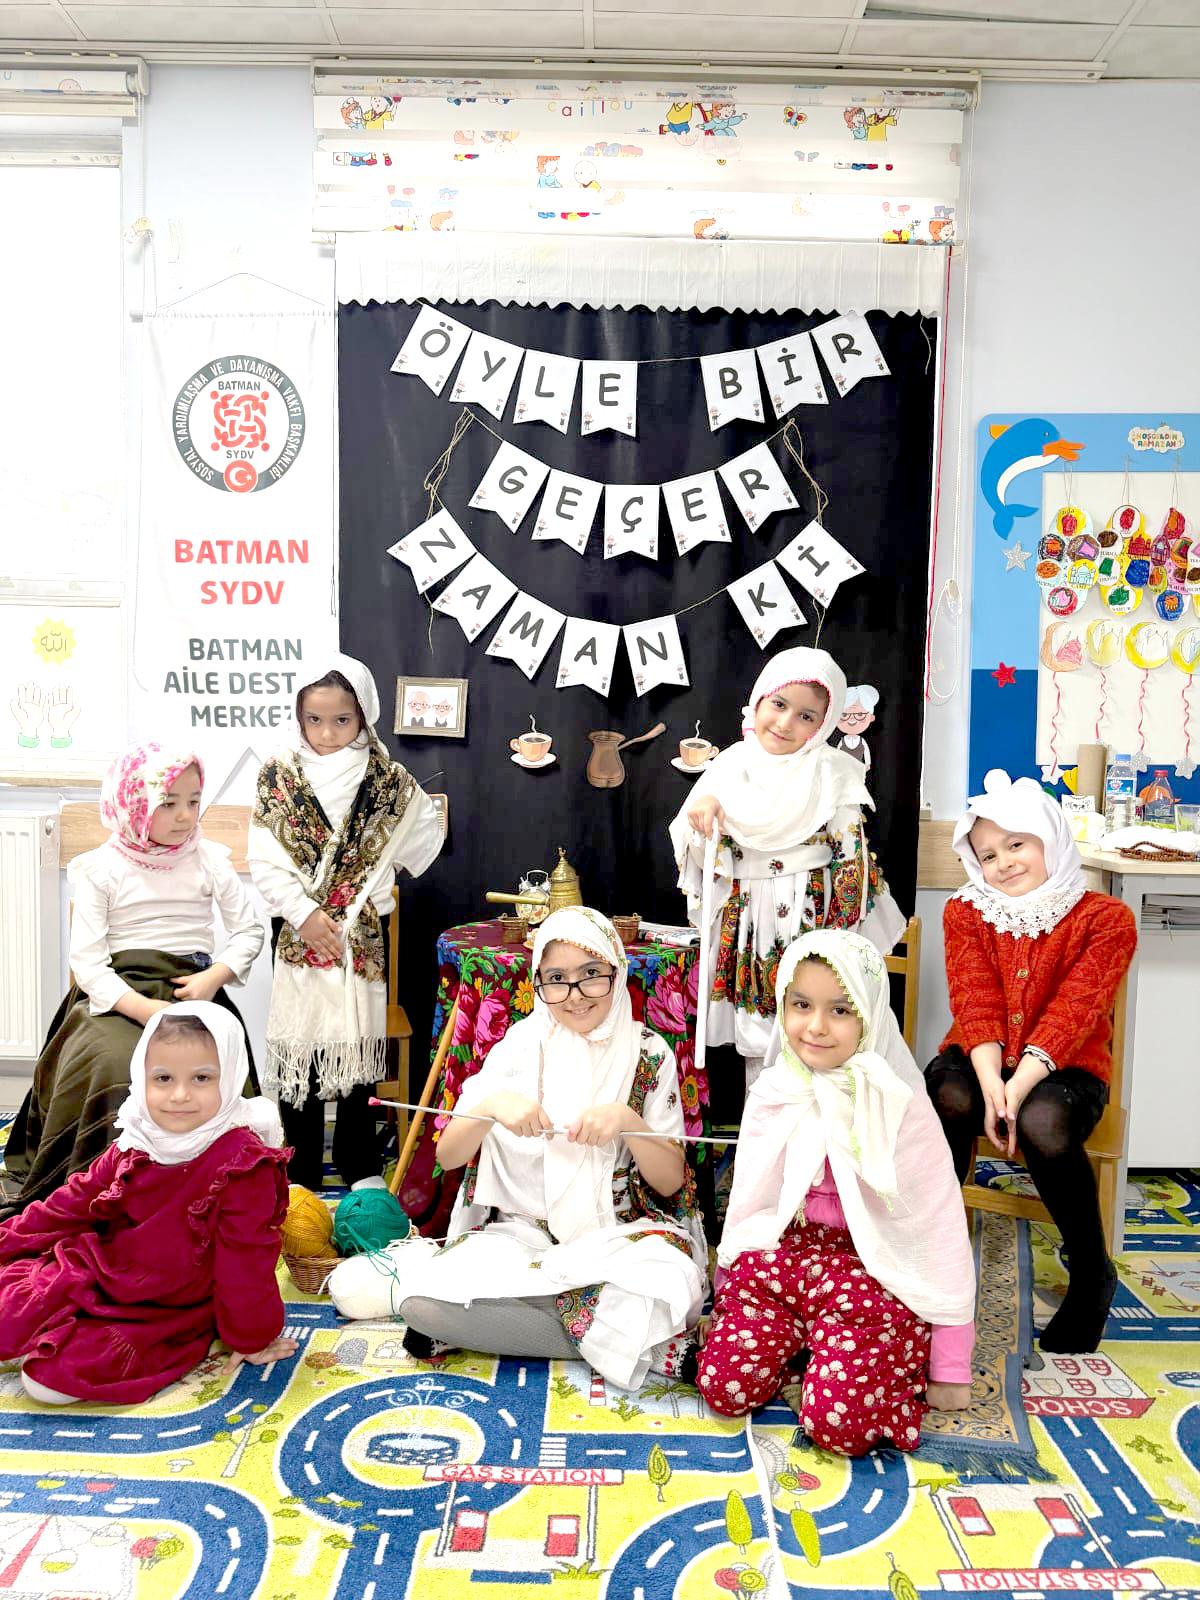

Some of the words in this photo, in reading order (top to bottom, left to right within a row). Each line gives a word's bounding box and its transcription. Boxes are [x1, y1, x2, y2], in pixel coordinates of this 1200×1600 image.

[419, 321, 621, 407] ÖYLE
[718, 332, 862, 400] BİR
[218, 380, 261, 391] BATMAN
[183, 446, 215, 481] SOSYAL
[209, 362, 225, 375] VE
[226, 449, 255, 460] SYDV
[498, 464, 770, 533] GEÇER
[174, 538, 309, 564] BATMAN
[200, 580, 285, 605] SYDV
[419, 527, 668, 666] ZAMAN
[747, 545, 830, 617] Kİ
[188, 637, 303, 661] BATMAN
[163, 666, 220, 694] AİLE
[228, 672, 297, 694] DEST
[190, 705, 292, 728] MERKE
[1023, 1400, 1132, 1415] SCHOO
[441, 1465, 493, 1480] GAS
[500, 1467, 606, 1483] STATION
[958, 1572, 1078, 1590] STATION
[1083, 1572, 1143, 1589] GAS
